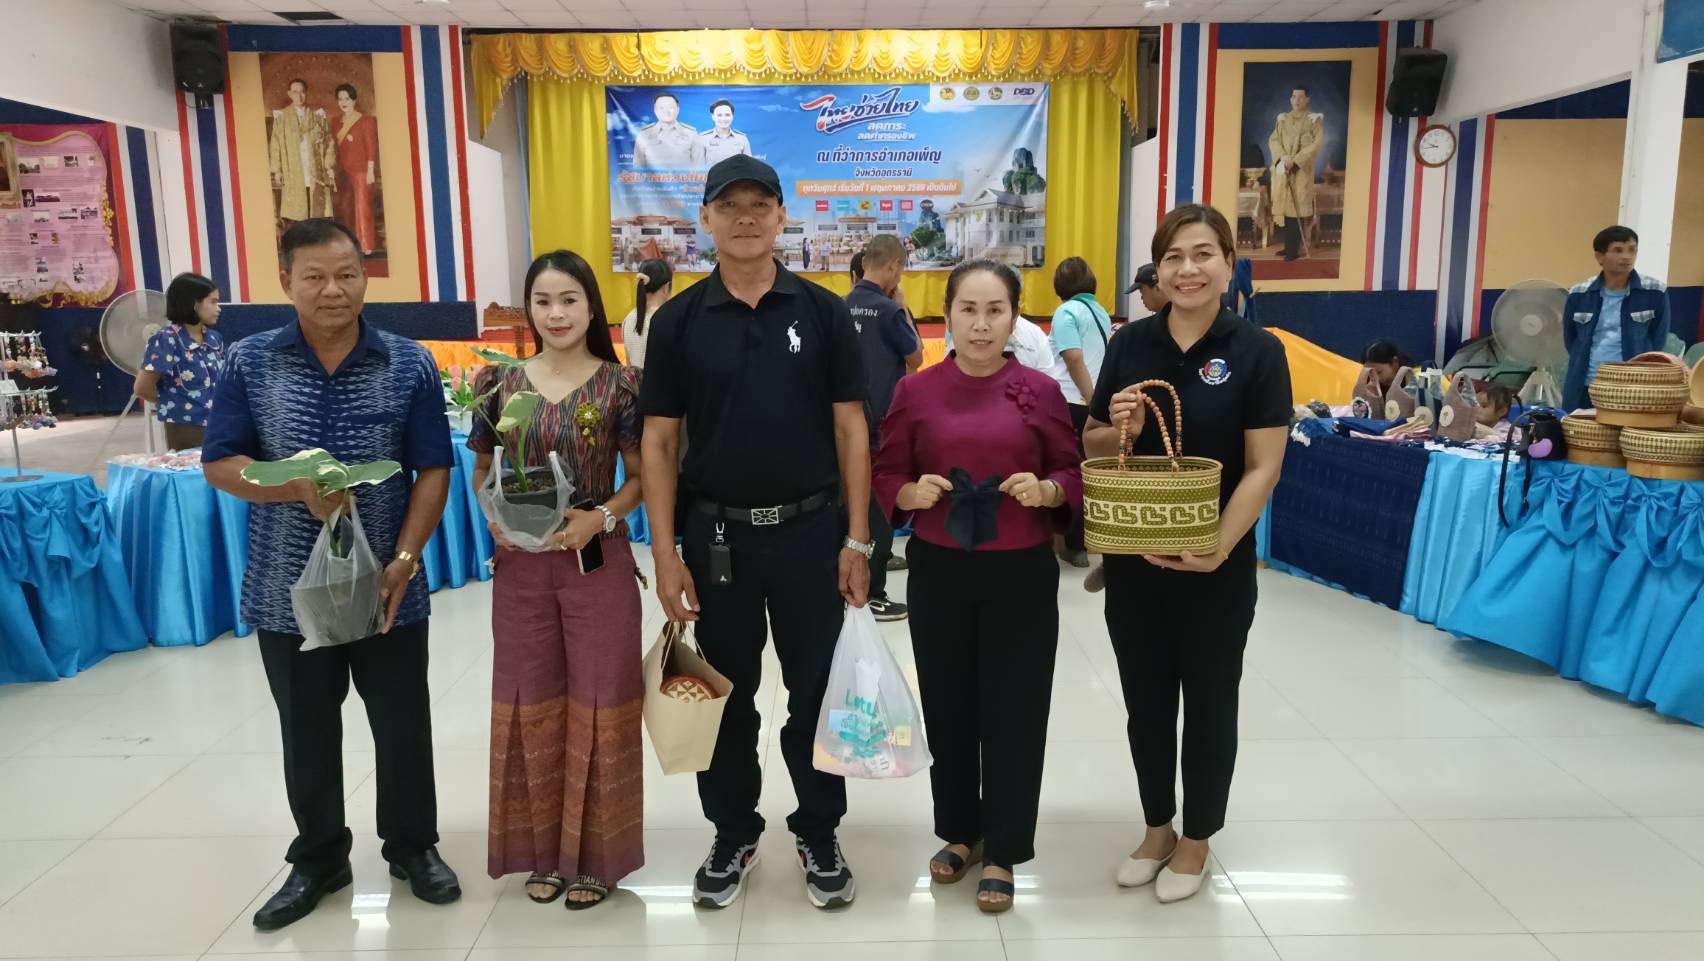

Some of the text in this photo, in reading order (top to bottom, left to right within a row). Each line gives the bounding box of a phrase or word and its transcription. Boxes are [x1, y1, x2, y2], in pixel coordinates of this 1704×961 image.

[1013, 87, 1035, 96] DBD
[801, 88, 919, 131] ไทยช่วยไทย
[867, 122, 906, 131] ลดภาระ
[817, 144, 942, 164] ณ ที่ว่าการอำเภอเพ็ญ
[855, 167, 912, 178] จังหวัดอุดรธานี
